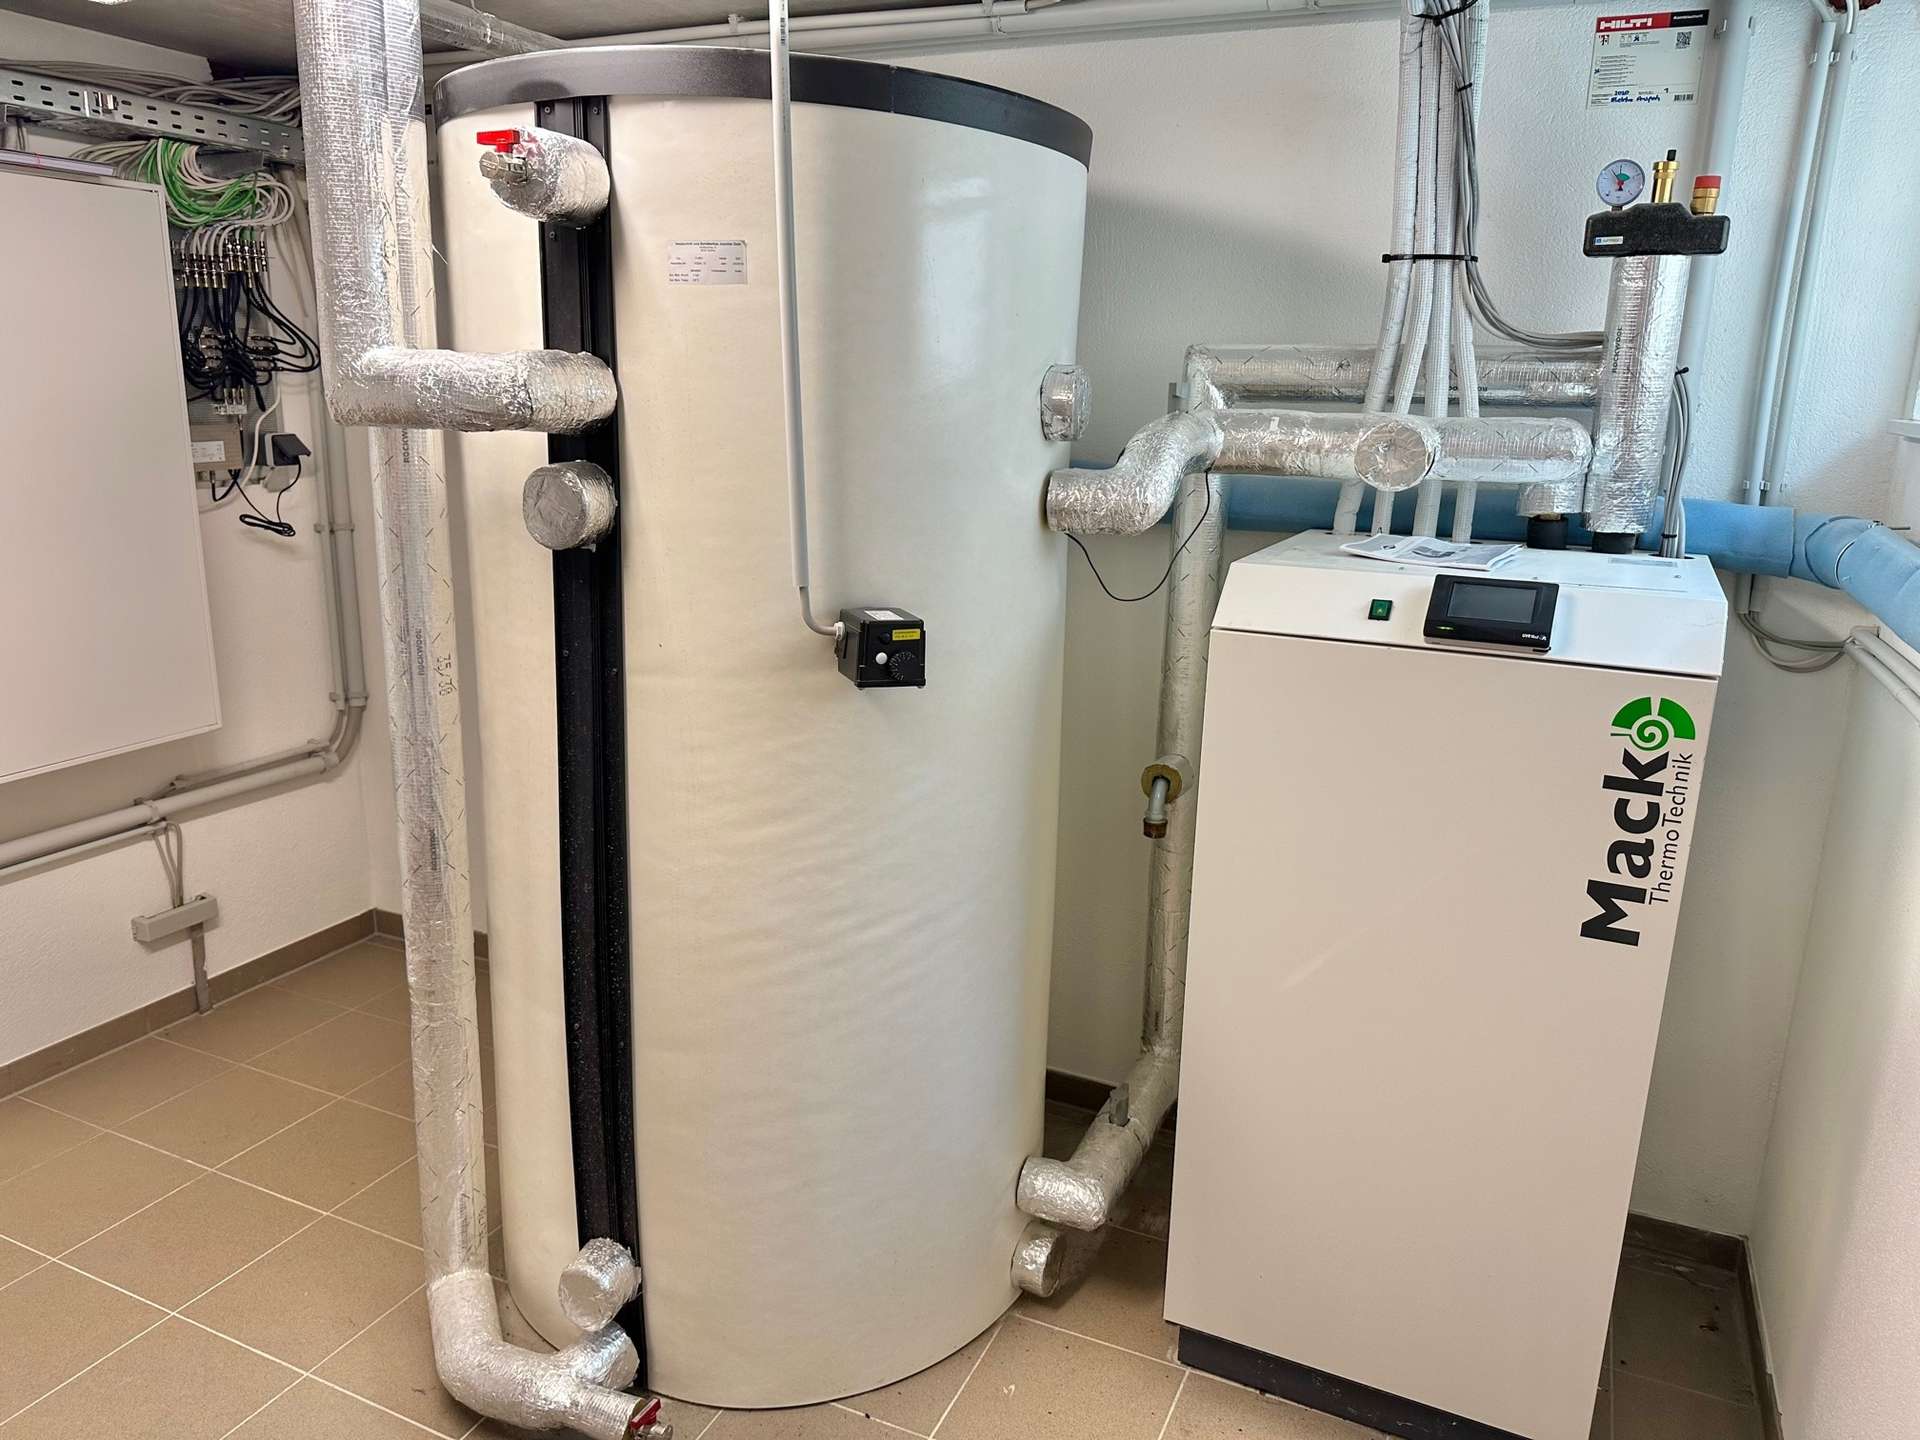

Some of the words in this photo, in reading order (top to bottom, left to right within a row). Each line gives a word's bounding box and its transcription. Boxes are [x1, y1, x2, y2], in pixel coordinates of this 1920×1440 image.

[1600, 18, 1652, 29] HILTI
[415, 628, 425, 676] ROCKWOOL
[1580, 748, 1670, 947] Mack
